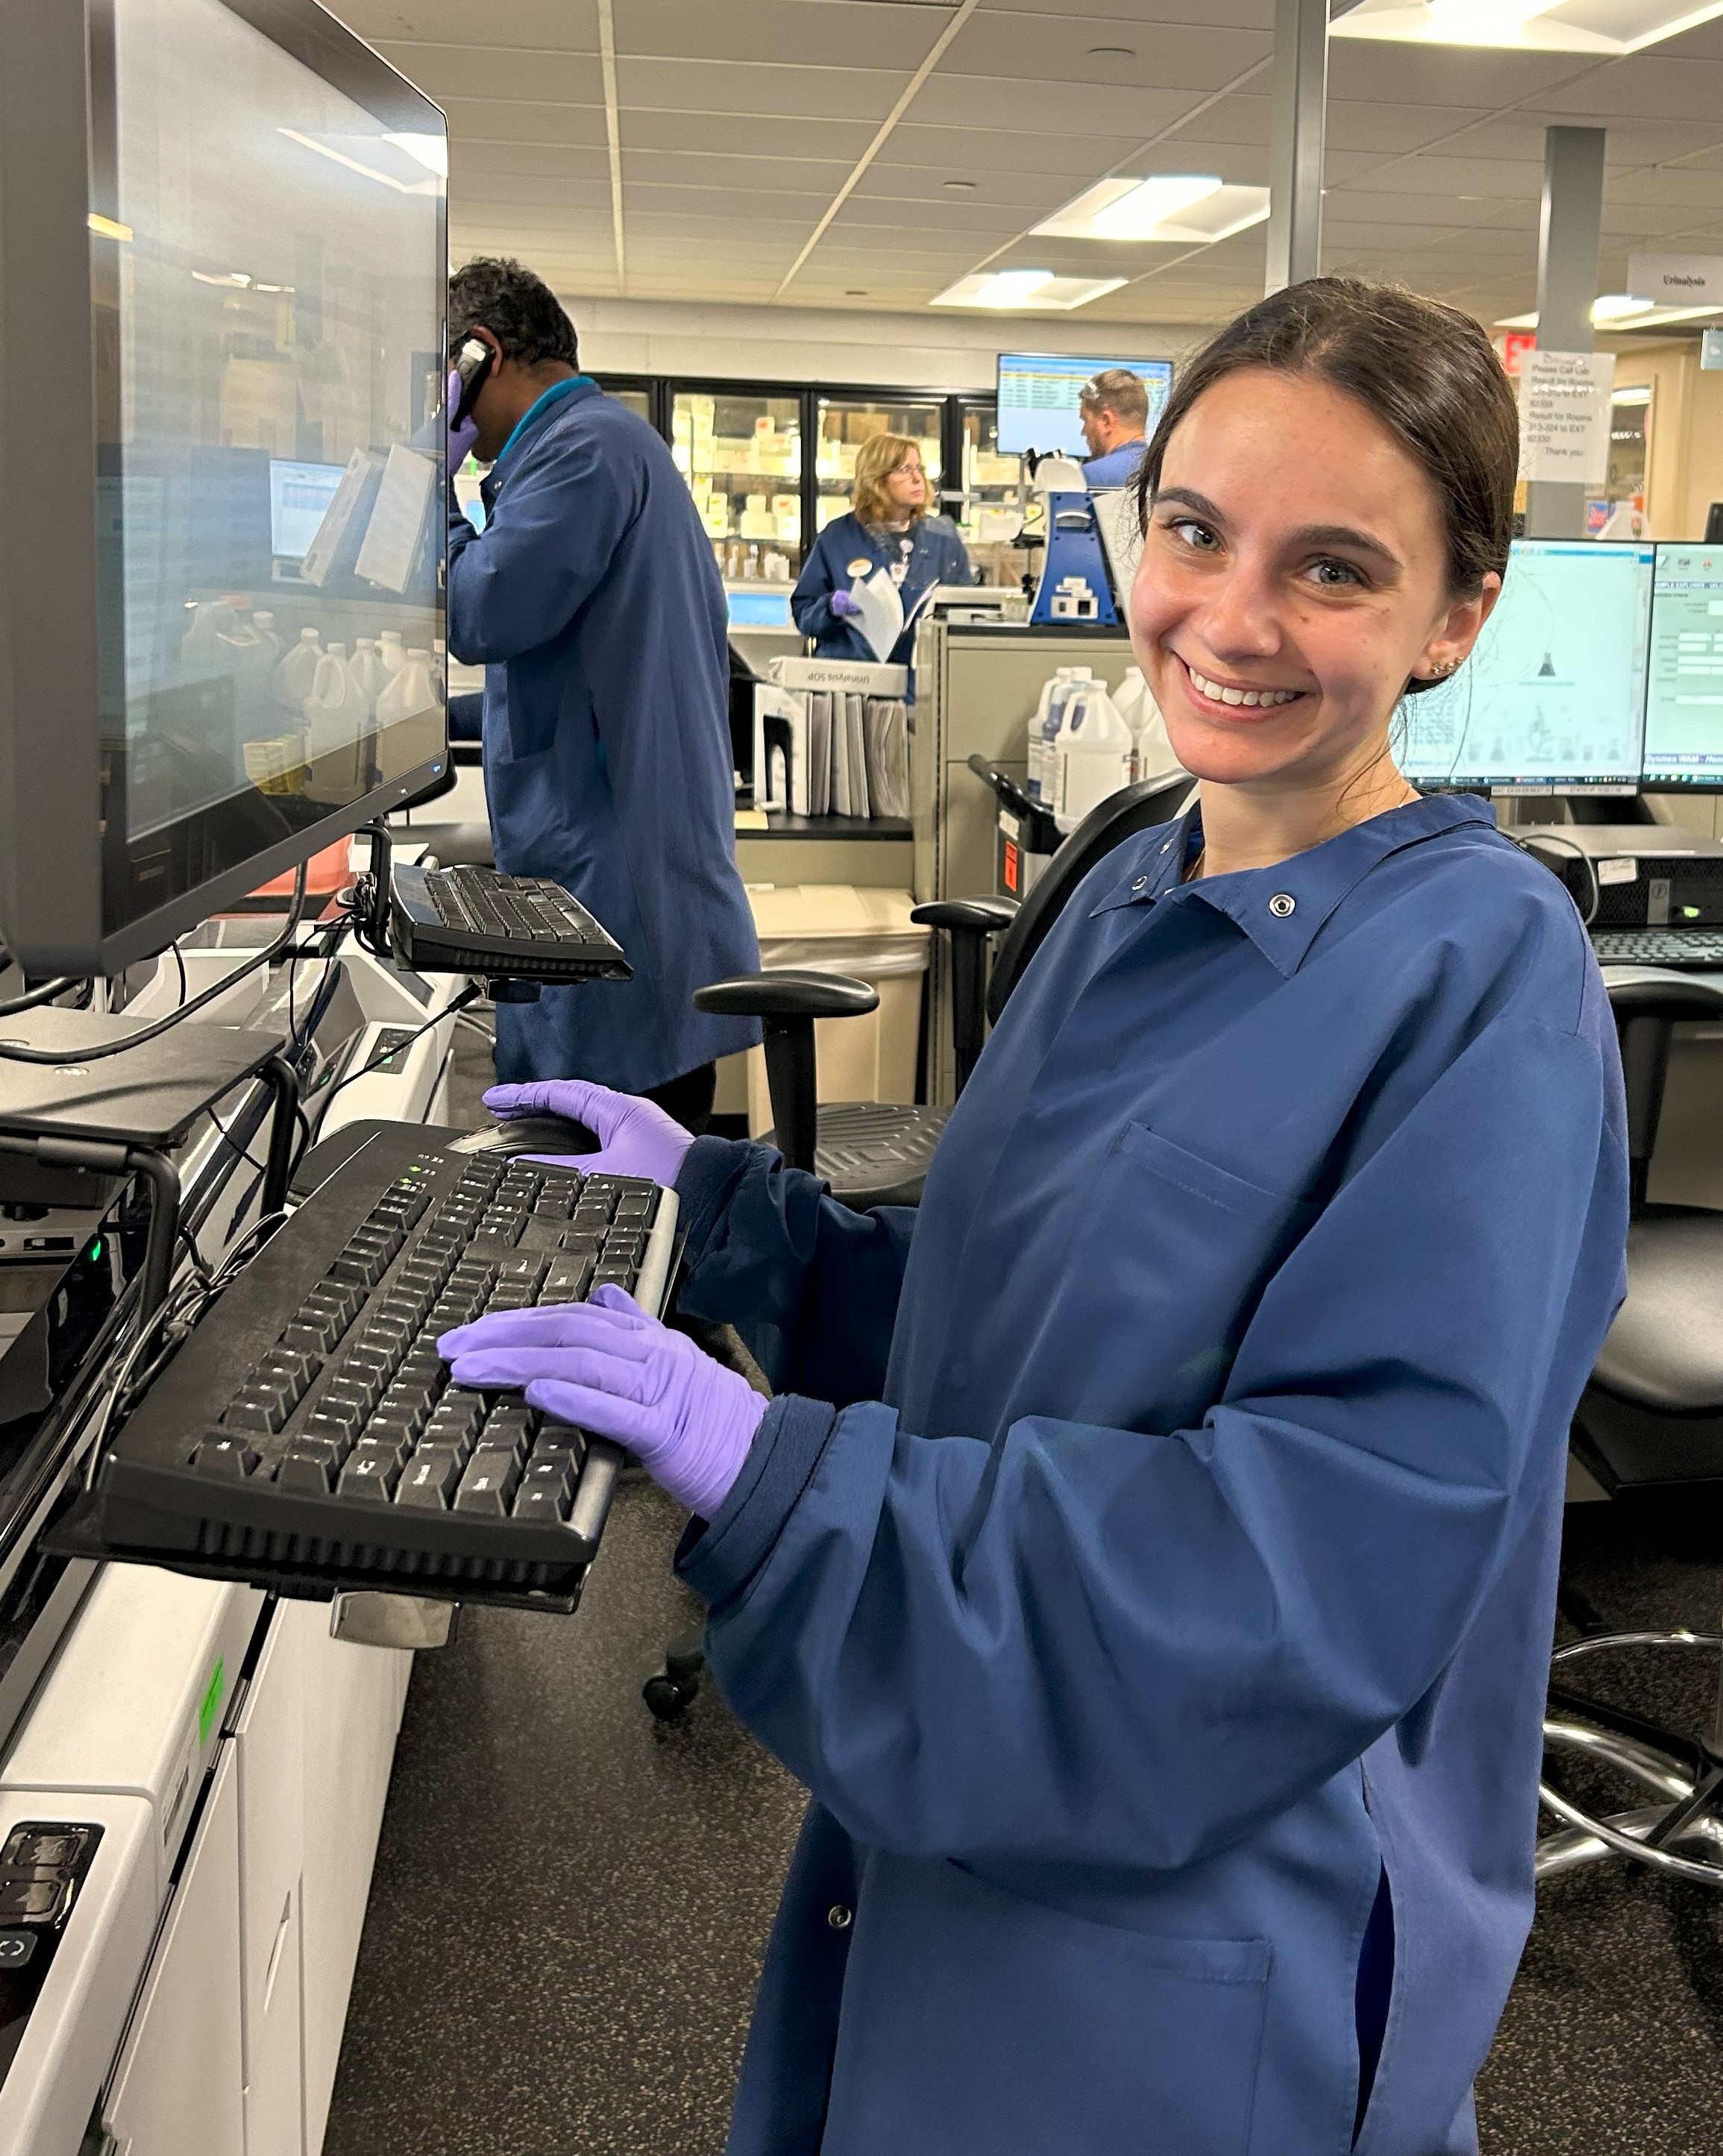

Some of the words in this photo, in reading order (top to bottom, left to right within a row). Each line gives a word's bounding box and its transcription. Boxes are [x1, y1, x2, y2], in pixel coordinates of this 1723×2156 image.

[1663, 274, 1706, 289] Urinalysis
[807, 672, 826, 682] SOP
[827, 673, 870, 685] Urinalysis
